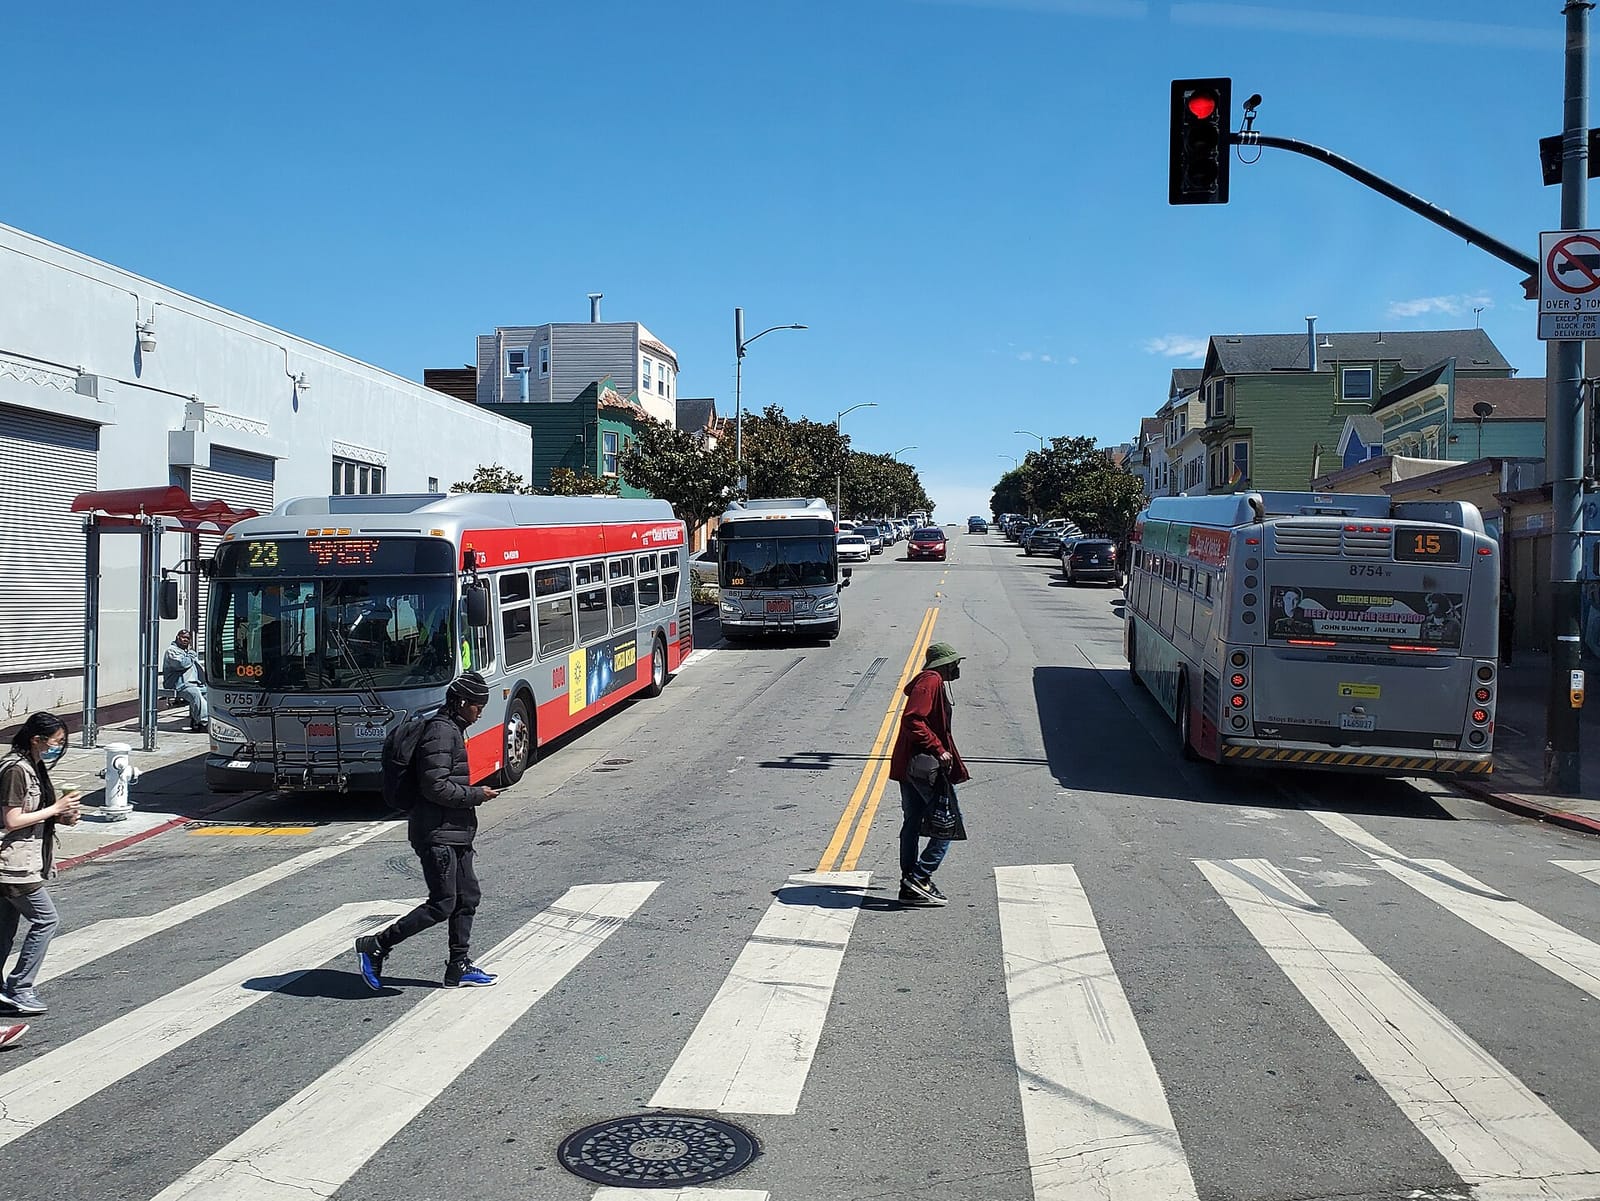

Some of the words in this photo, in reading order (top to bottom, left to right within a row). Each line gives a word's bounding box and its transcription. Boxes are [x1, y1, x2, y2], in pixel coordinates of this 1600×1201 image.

[1546, 299, 1570, 309] OVER
[1573, 297, 1582, 311] 3
[1414, 534, 1441, 554] 15
[248, 542, 279, 567] 23
[1349, 564, 1383, 577] 8754
[731, 578, 745, 586] 103
[1303, 608, 1327, 619] MEET
[1327, 610, 1346, 621] YOU
[1347, 611, 1359, 621] AT
[1360, 611, 1377, 622] THE
[1377, 612, 1400, 623] BEAT
[1401, 614, 1426, 624] DROP
[236, 665, 264, 677] 088
[224, 692, 253, 705] 8755
